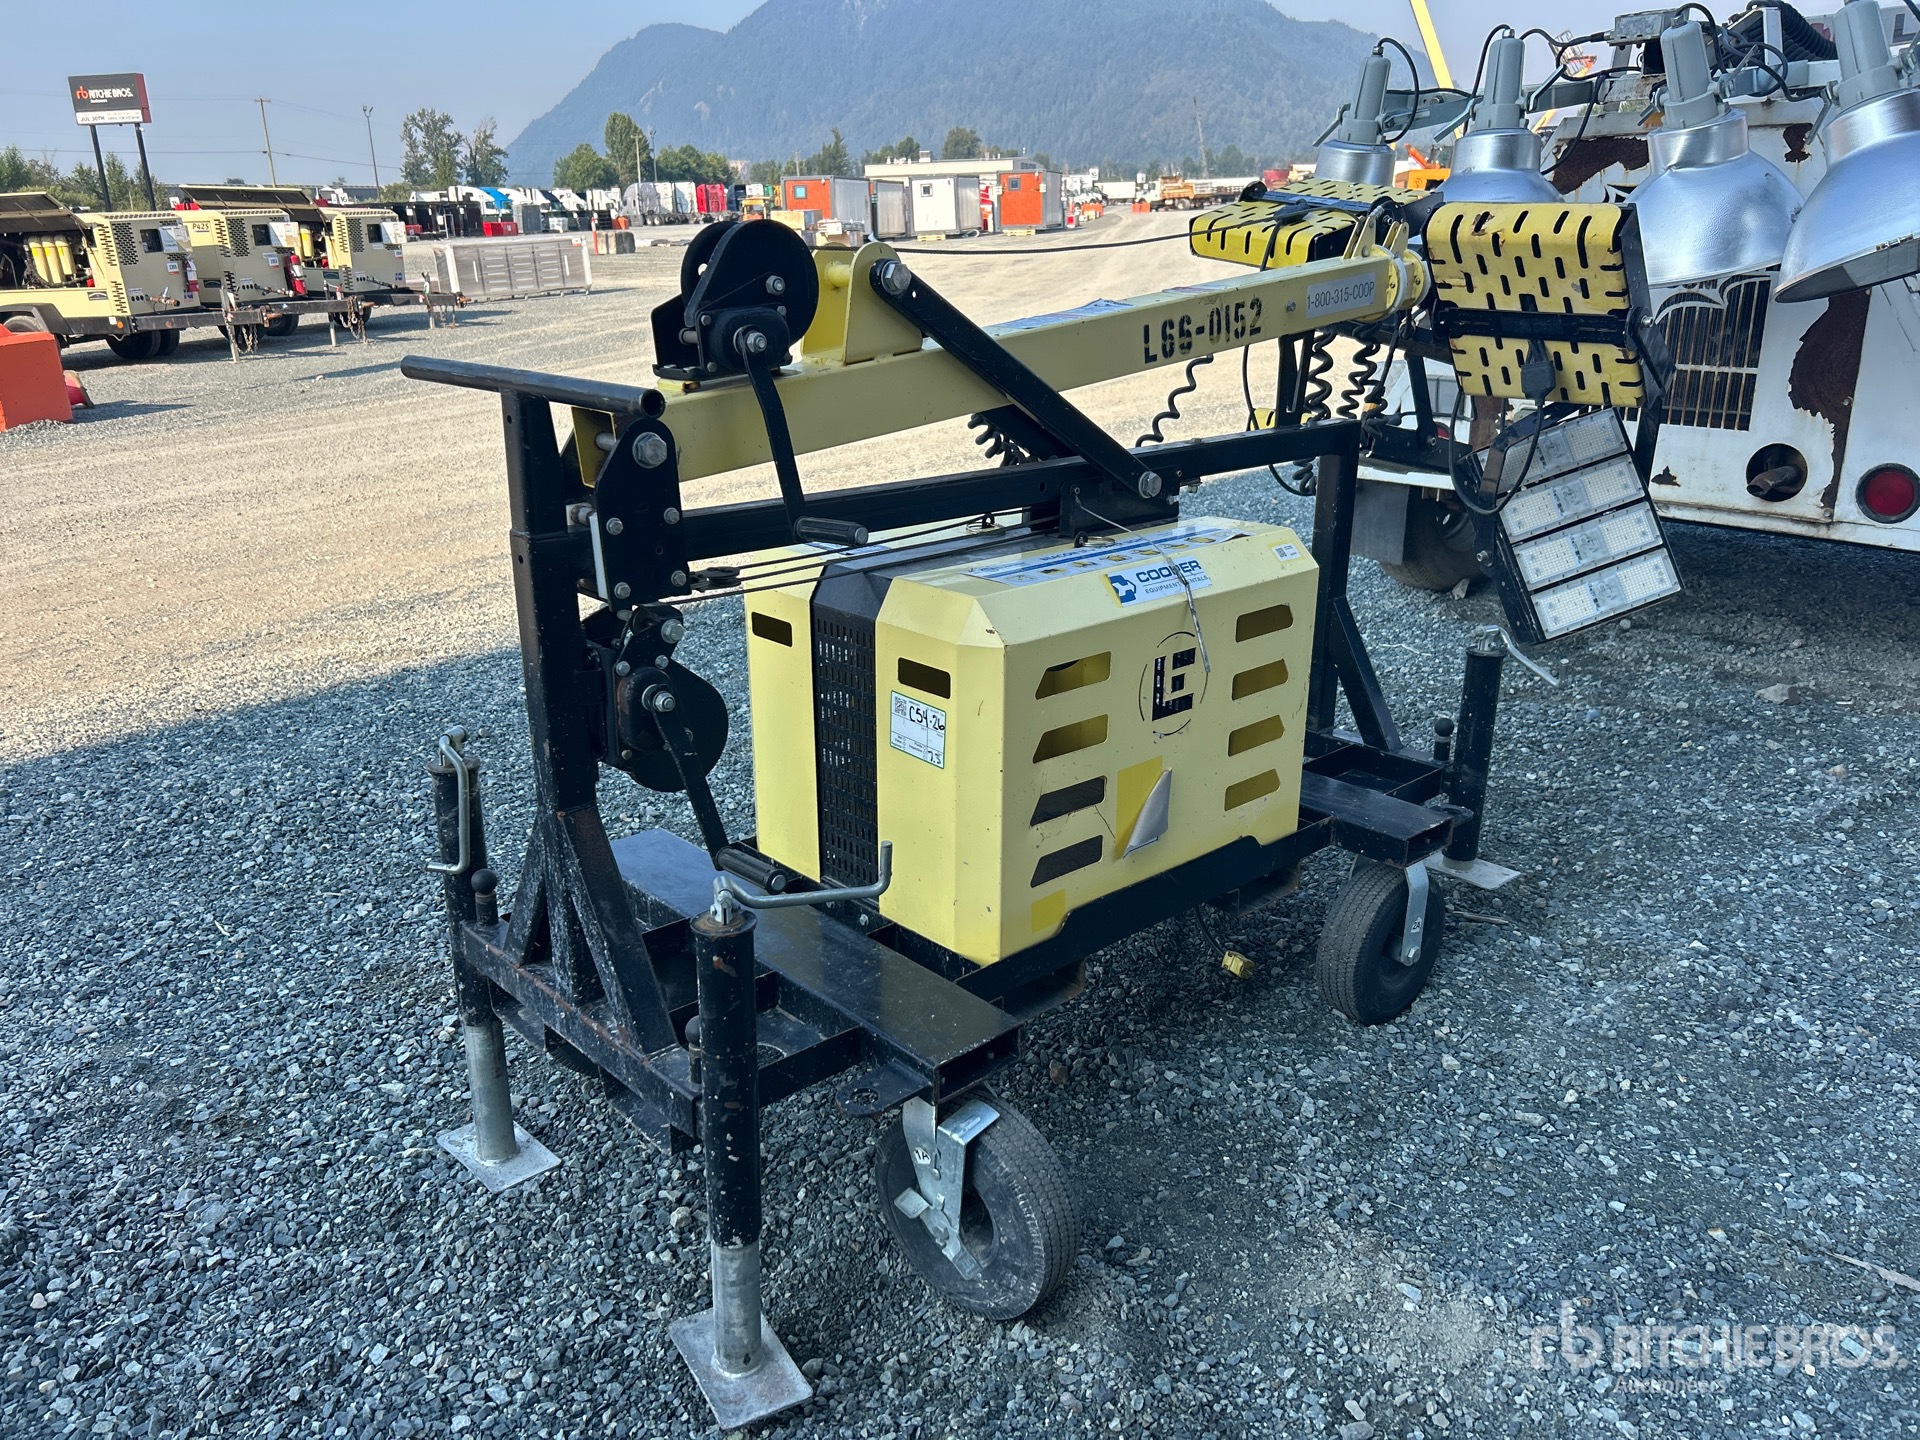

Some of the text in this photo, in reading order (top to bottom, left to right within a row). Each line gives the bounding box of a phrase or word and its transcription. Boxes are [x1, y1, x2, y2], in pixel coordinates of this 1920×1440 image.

[89, 89, 112, 98] RITCHIE
[1307, 281, 1375, 310] 1-800-315-COOP
[1145, 582, 1181, 594] EQUIPMENT
[915, 1149, 930, 1160] 1A
